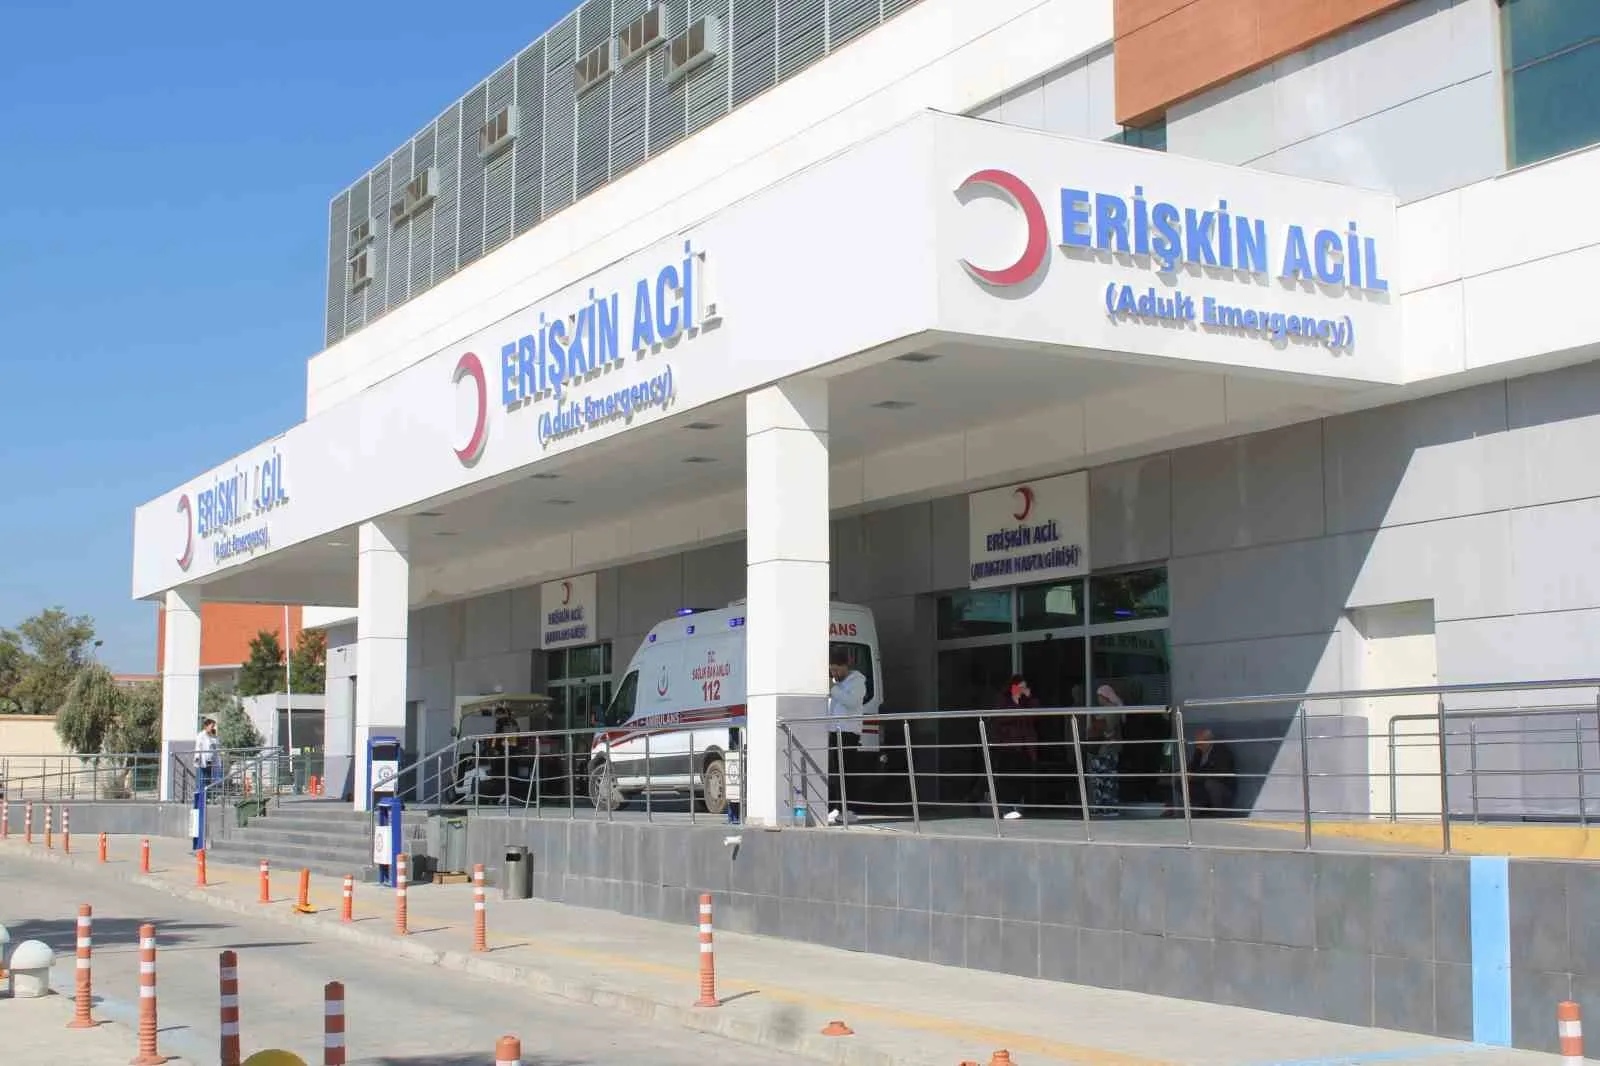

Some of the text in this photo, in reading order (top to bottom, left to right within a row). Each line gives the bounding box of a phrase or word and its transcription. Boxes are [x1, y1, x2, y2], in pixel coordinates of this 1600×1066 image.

[1060, 186, 1388, 291] ERİŞKİN ACİL
[1105, 283, 1355, 347] (Adult Emergency)
[538, 364, 674, 444] (Adult Emergency)
[1033, 519, 1059, 544] ACİL
[829, 623, 857, 636] ANS
[702, 680, 721, 702] 112
